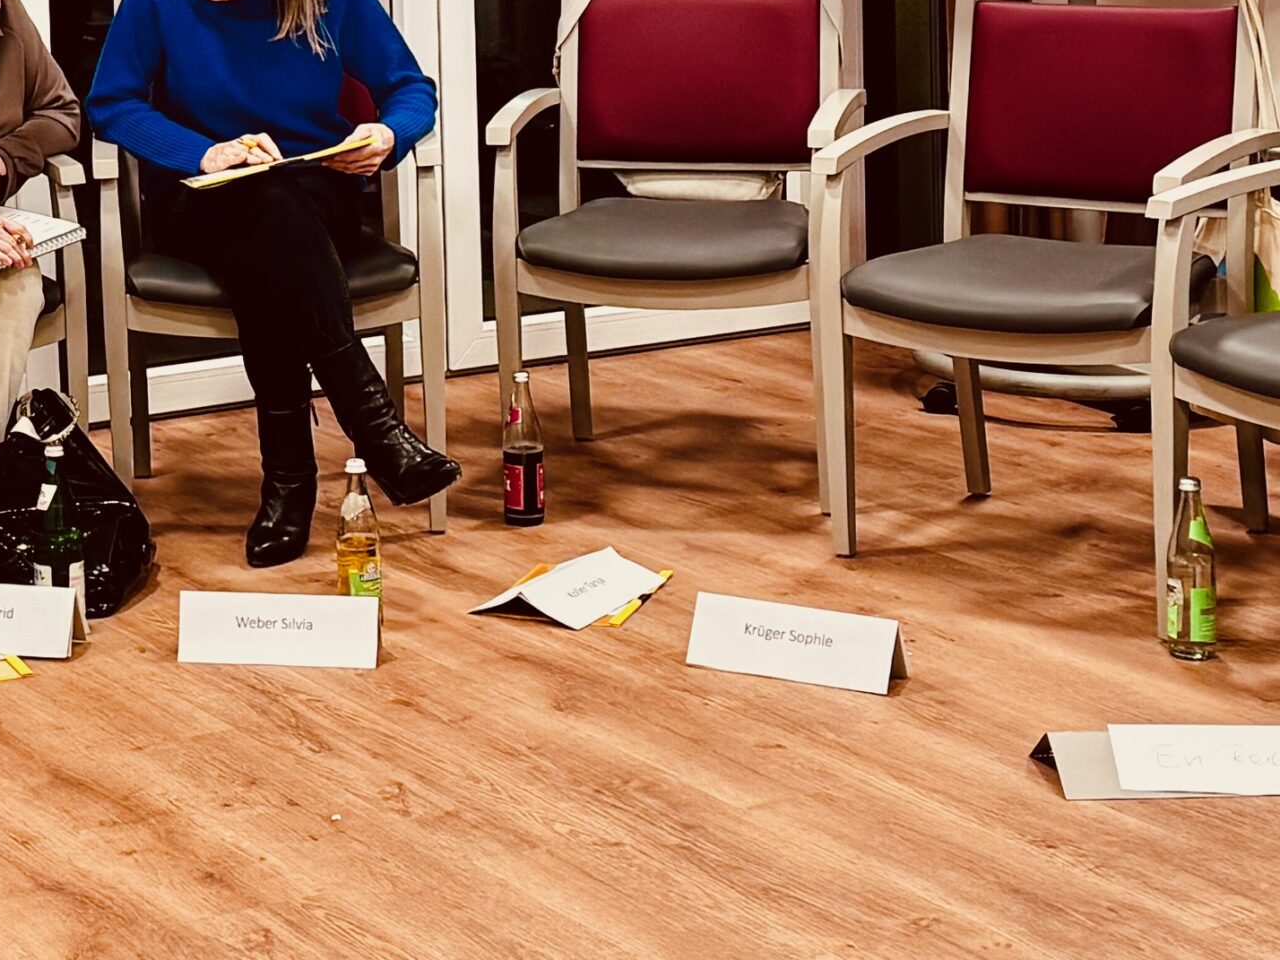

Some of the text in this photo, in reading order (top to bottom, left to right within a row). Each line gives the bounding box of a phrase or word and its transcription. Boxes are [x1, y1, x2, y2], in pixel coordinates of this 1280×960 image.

[235, 615, 314, 631] Weber Silvia
[743, 623, 834, 648] Krüger Sophie
